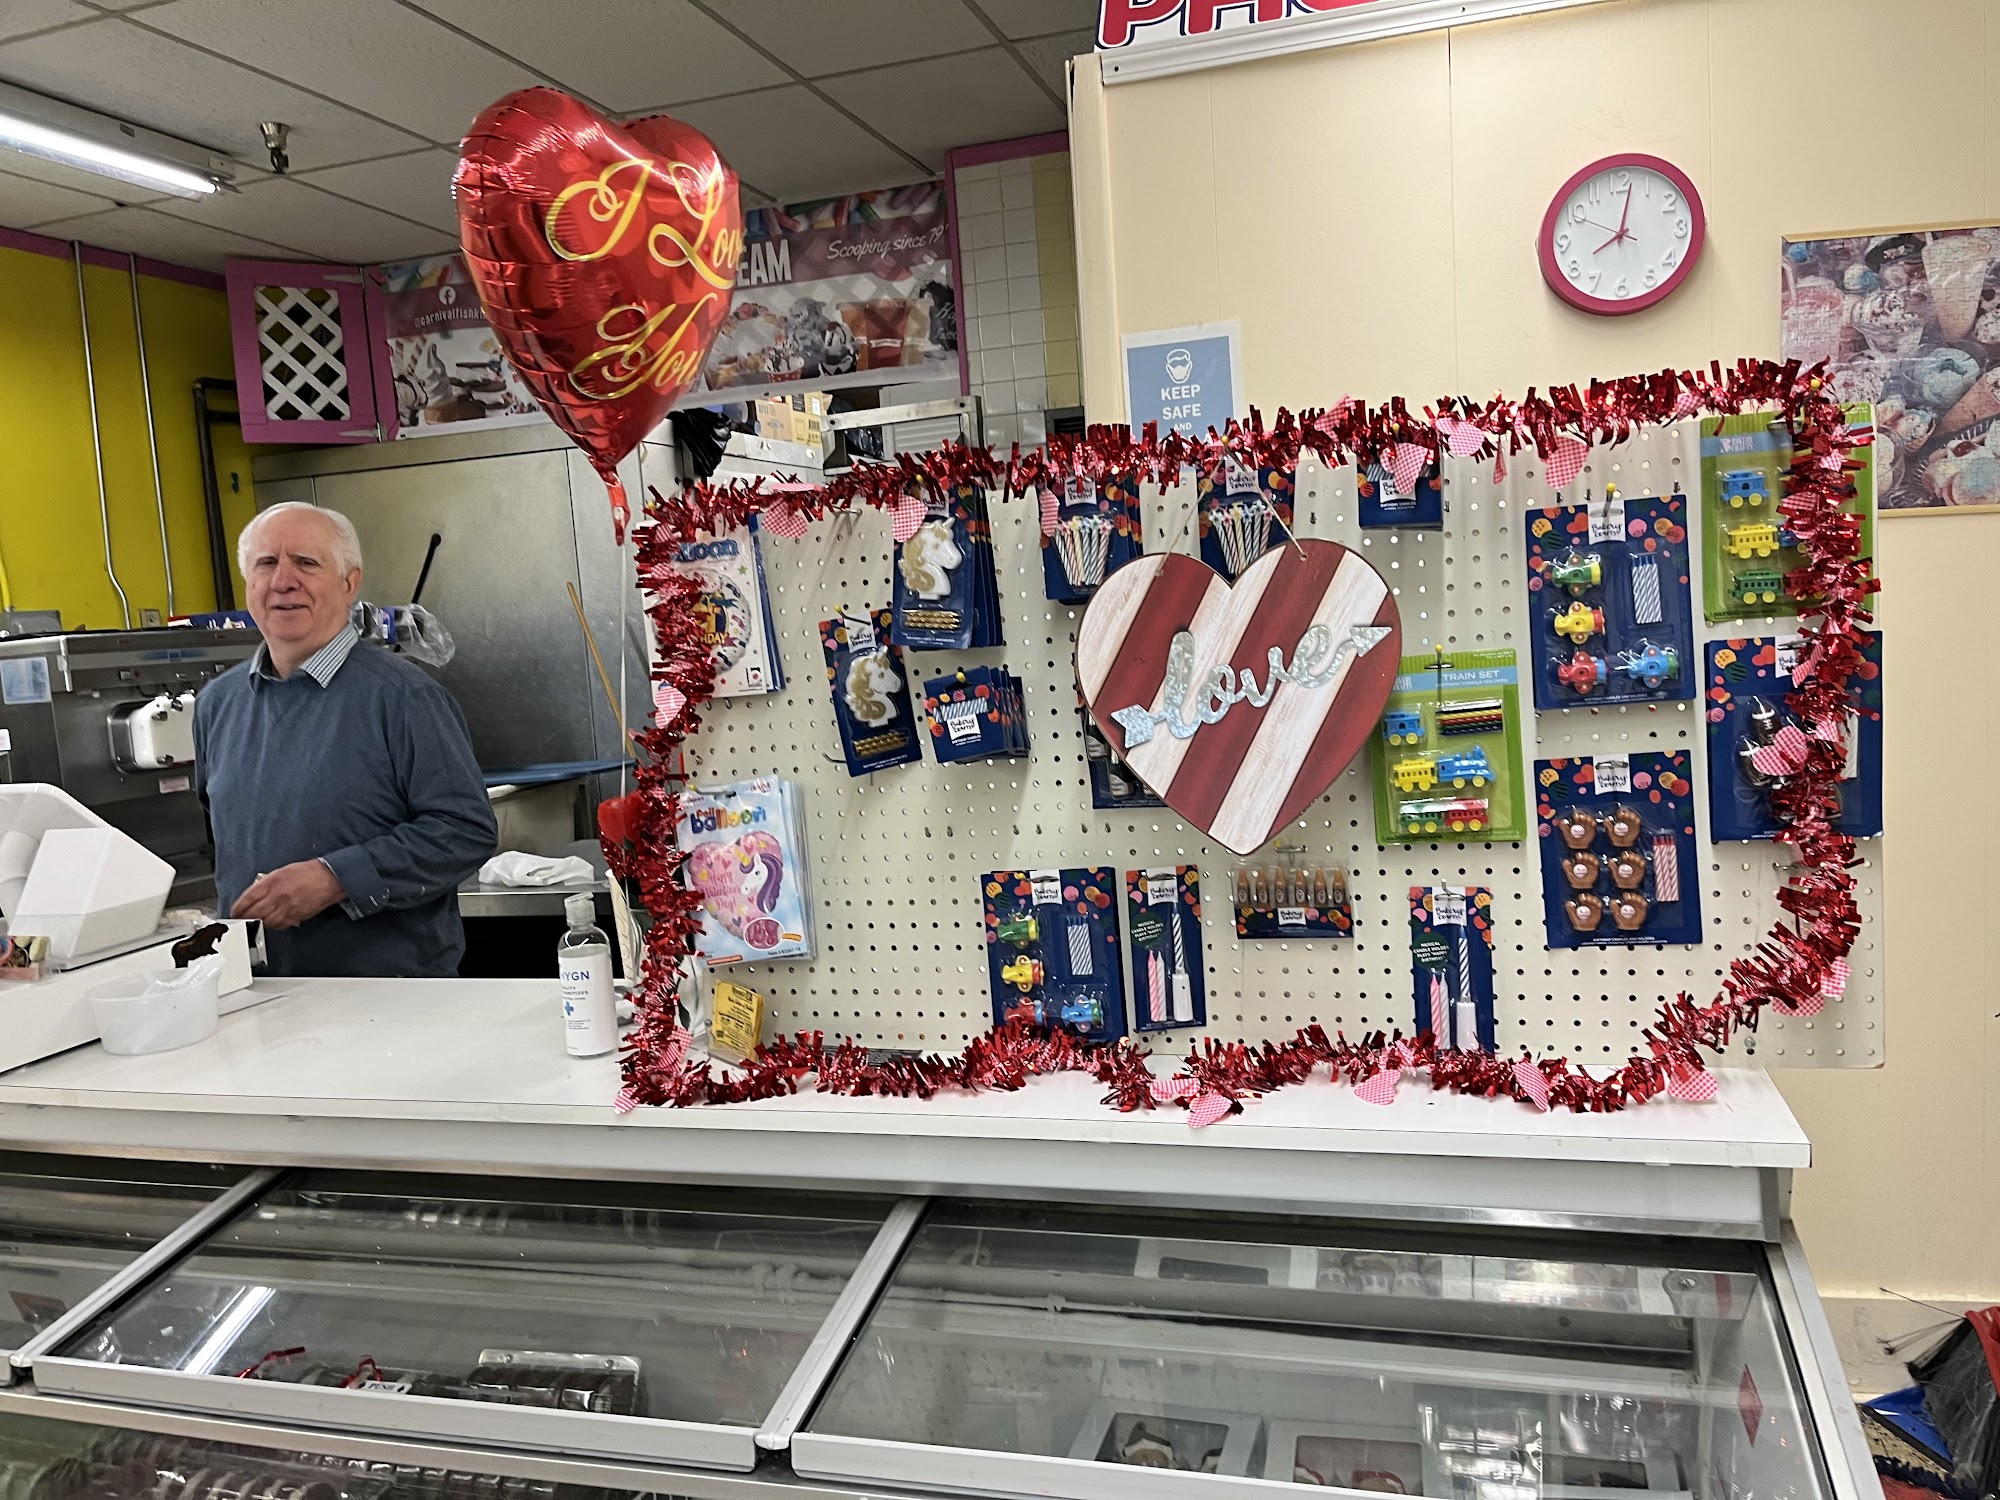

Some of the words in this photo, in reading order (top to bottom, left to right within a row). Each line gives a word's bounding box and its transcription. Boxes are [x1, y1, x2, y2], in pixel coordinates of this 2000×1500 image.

[1588, 182, 1600, 204] 11
[1609, 171, 1631, 195] 12
[1644, 175, 1650, 197] 1
[1662, 191, 1677, 214] 2
[648, 151, 742, 289] Lov
[1567, 204, 1586, 226] 10
[1673, 216, 1688, 238] 3
[827, 239, 891, 262] Scooping
[893, 233, 927, 251] since
[1556, 234, 1571, 254] 9
[1662, 248, 1677, 268] 4
[1568, 260, 1581, 279] 8
[1643, 265, 1657, 288] 5
[1588, 271, 1602, 293] 7
[1614, 275, 1629, 297] 6
[415, 307, 486, 329] @carnivalfishki
[568, 292, 718, 399] You
[1160, 384, 1201, 401] KEEP
[1162, 403, 1202, 420] SAFE
[1173, 422, 1192, 432] AND
[1164, 624, 1354, 739] love
[1443, 672, 1476, 682] TRAIN
[1478, 670, 1500, 679] SET
[690, 806, 767, 834] balloon
